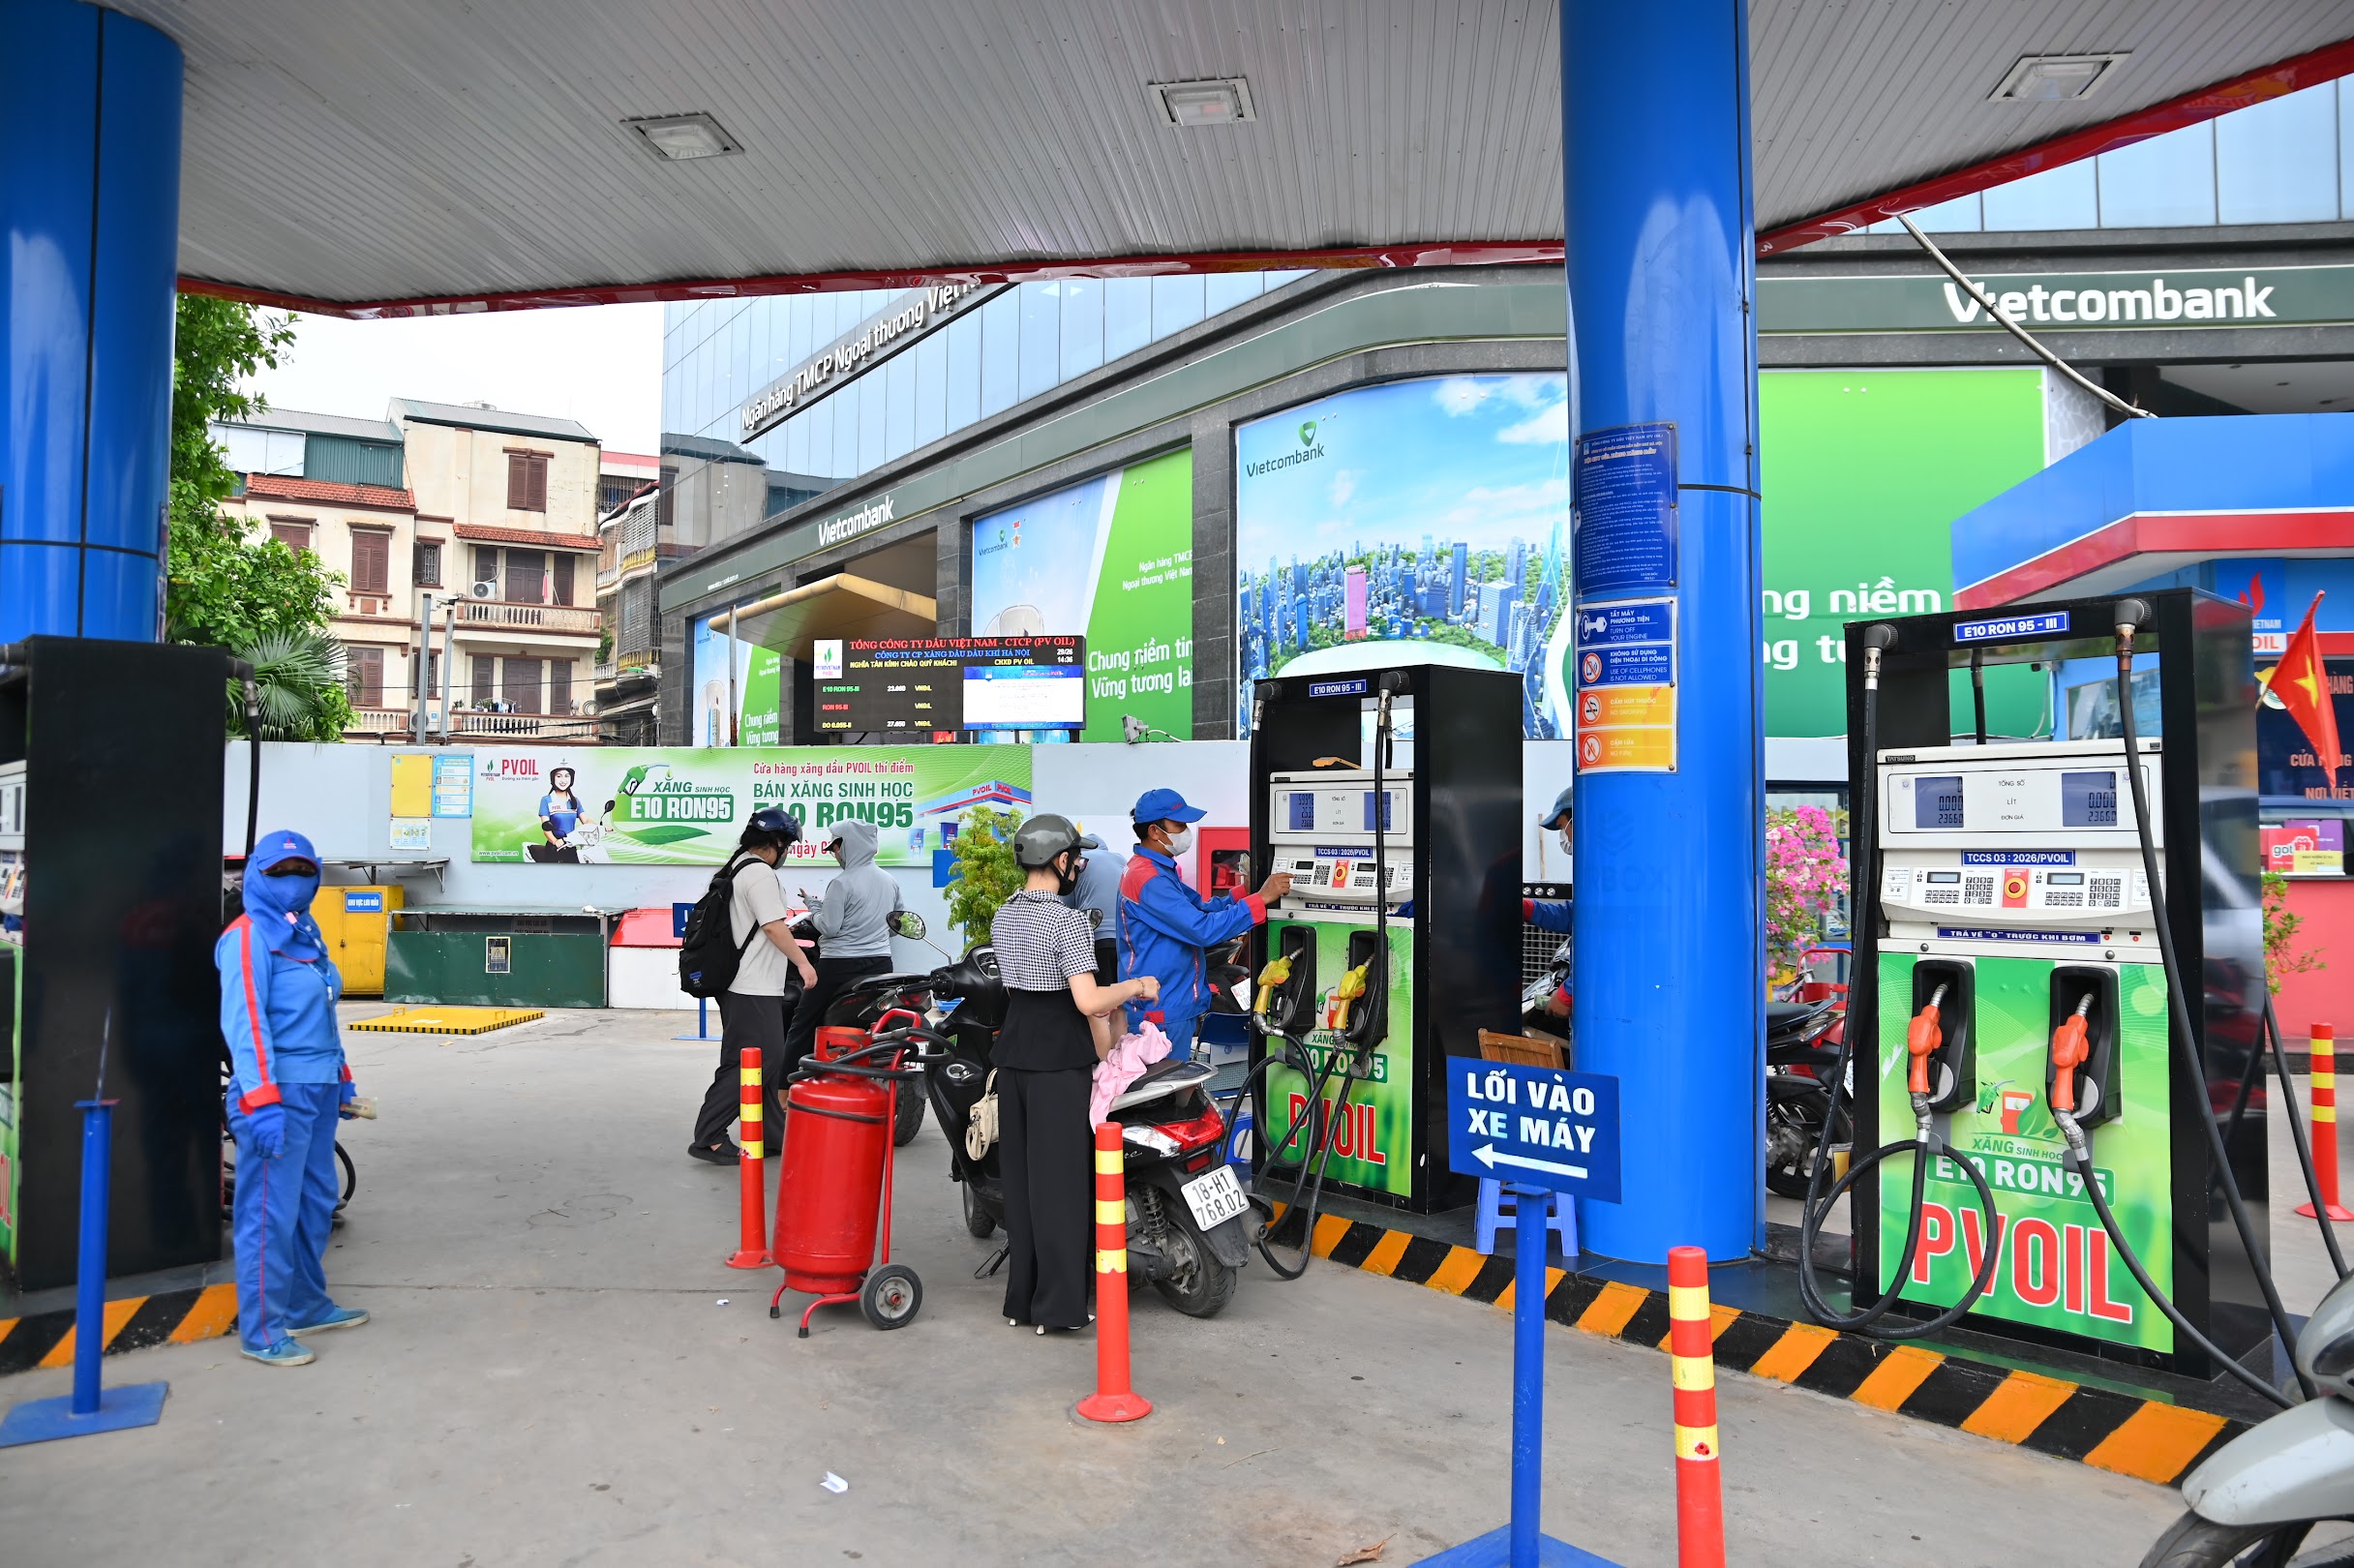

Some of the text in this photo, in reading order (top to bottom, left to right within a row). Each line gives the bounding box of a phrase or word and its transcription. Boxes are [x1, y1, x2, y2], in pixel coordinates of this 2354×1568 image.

[1944, 277, 2277, 322] Vietcombank
[741, 398, 767, 430] Ngân
[769, 387, 794, 413] hàng
[796, 354, 831, 396] TMCP
[834, 329, 871, 373] Ngoại
[873, 300, 924, 347] thương
[1247, 443, 1324, 477] Vietcombank
[819, 496, 893, 546] Vietcombank
[979, 540, 1009, 557] Vietcombank
[1139, 560, 1155, 573] Ngân
[1829, 576, 1942, 614] niềm
[1964, 618, 2058, 638] E10 RON 95 III
[880, 639, 908, 649] CÔNG
[910, 640, 923, 648] TY
[950, 638, 972, 648] VIỆT
[974, 639, 997, 648] NAM
[1005, 638, 1032, 647] CTCP
[1035, 637, 1051, 648] (PV
[1053, 637, 1075, 647] OIL)
[2253, 636, 2279, 649] OIL
[1014, 648, 1030, 658] NỘI
[1089, 649, 1131, 673] Chung
[1133, 637, 1170, 668] niềm
[1091, 674, 1127, 700] Vững
[1132, 673, 1172, 694] tương
[1326, 684, 1341, 693] RON
[1342, 683, 1350, 692] 95
[744, 708, 777, 728] Chung niềm
[501, 759, 539, 775] PVOIL
[753, 759, 914, 776] Cửa hàng xăng dầu PVOIL thí điểm
[2290, 749, 2315, 767] CỬA
[653, 776, 693, 793] XĂNG
[714, 786, 731, 795] HỌC
[753, 780, 913, 801] BÁN XĂNG SINH HỌC
[972, 784, 992, 796] PVOIL
[631, 797, 662, 819] E10
[667, 797, 731, 819] RON95
[2088, 811, 2116, 822] 23660
[1938, 813, 1963, 824] 23660
[1967, 853, 2069, 863] TCCS 03 2026/PVOIL
[2274, 845, 2293, 857] got
[1950, 929, 1969, 938] TRẢ
[1467, 1069, 1595, 1116] LỐI VÀO
[1467, 1107, 1595, 1154] XE MÁY
[1972, 1135, 2064, 1161] XĂNG SINH HỌC
[1936, 1155, 2106, 1199] E10 RON95
[1192, 1172, 1231, 1203] 18-H1
[1195, 1190, 1246, 1226] 768.02
[1911, 1201, 2133, 1324] PVOIL
